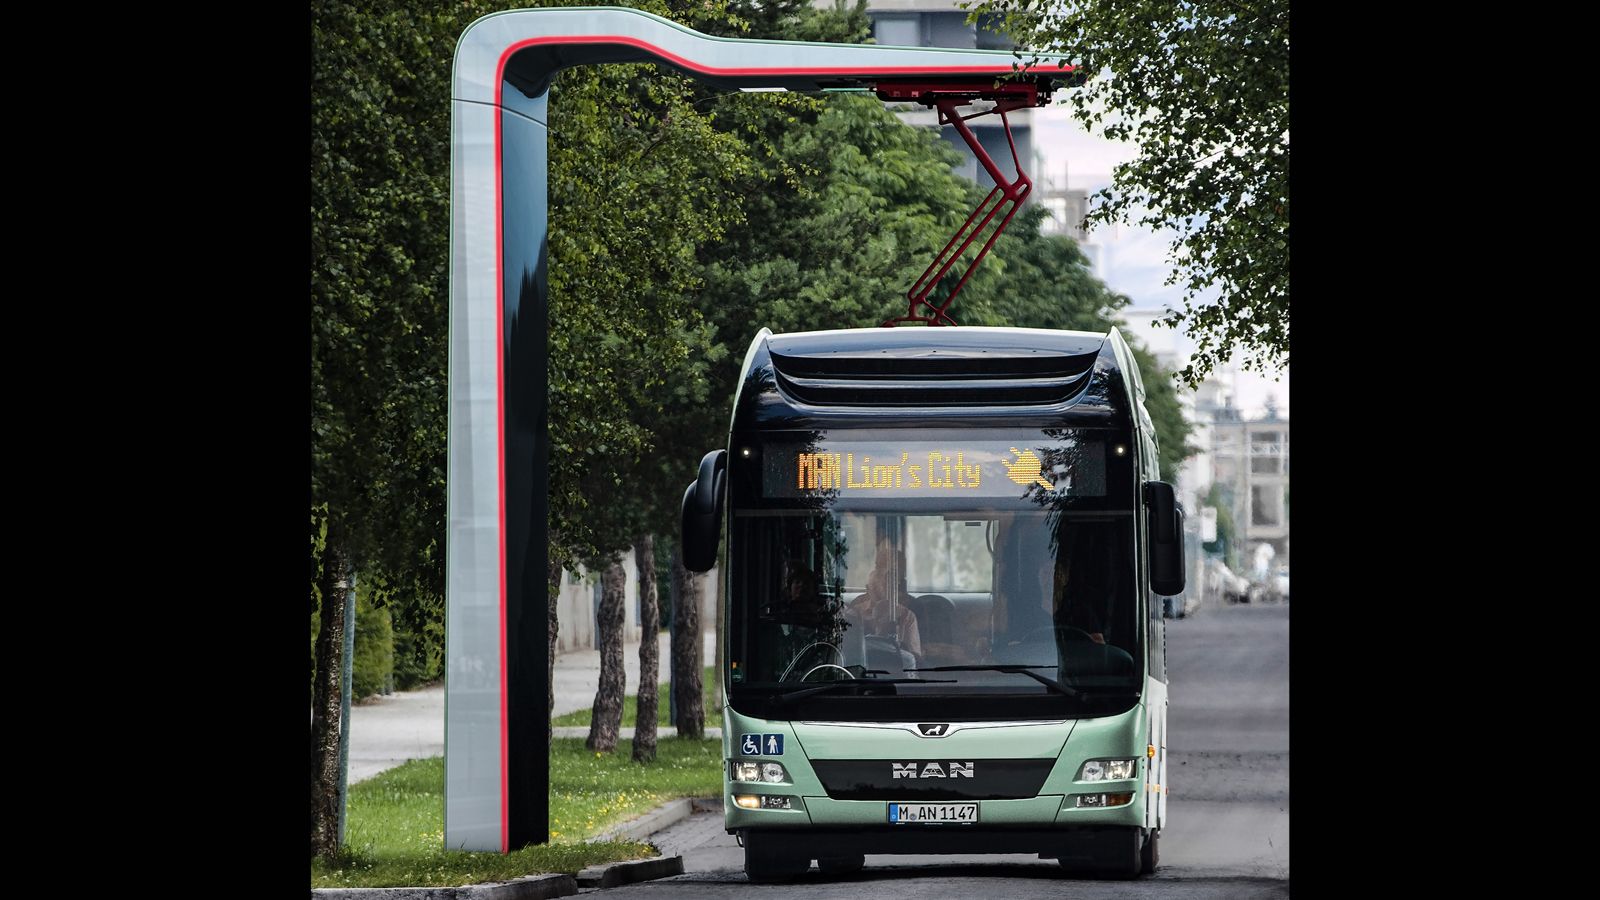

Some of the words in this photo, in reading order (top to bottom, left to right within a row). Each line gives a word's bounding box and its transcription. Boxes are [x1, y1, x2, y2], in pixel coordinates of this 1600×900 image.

[799, 453, 841, 489] MAN
[847, 452, 922, 489] Lion's
[928, 451, 981, 488] City
[892, 762, 974, 779] MAN
